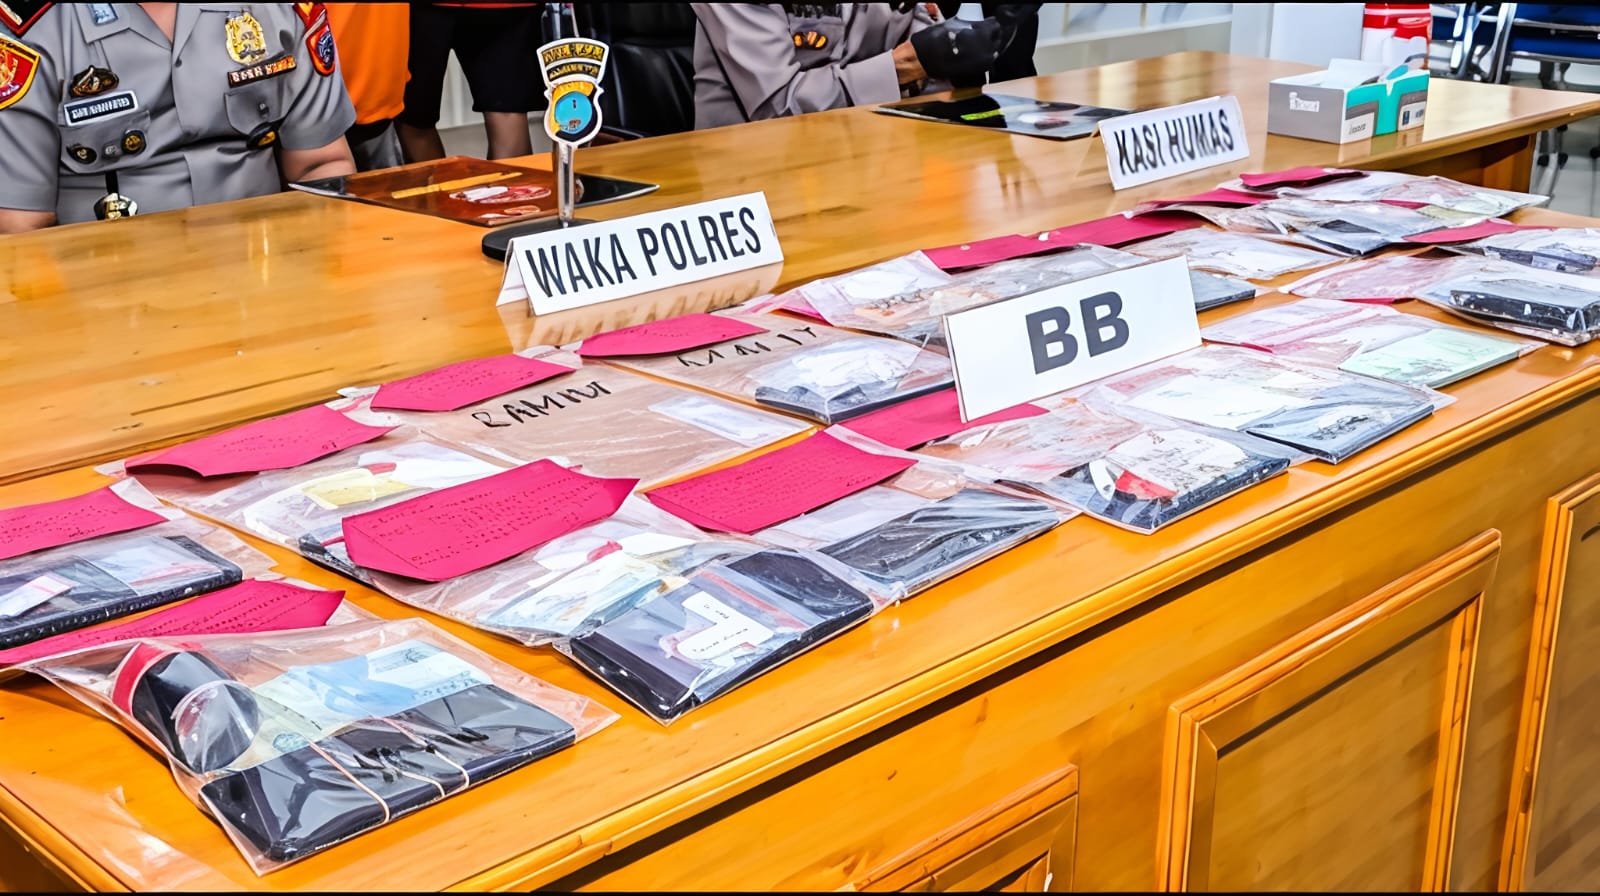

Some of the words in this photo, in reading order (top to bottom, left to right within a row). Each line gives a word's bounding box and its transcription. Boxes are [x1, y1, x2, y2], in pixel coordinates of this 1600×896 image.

[1113, 122, 1167, 176] KASI
[1165, 109, 1236, 165] HUMAS
[525, 233, 638, 298] WAKA
[637, 207, 762, 277] POLRES
[1025, 291, 1130, 375] BB
